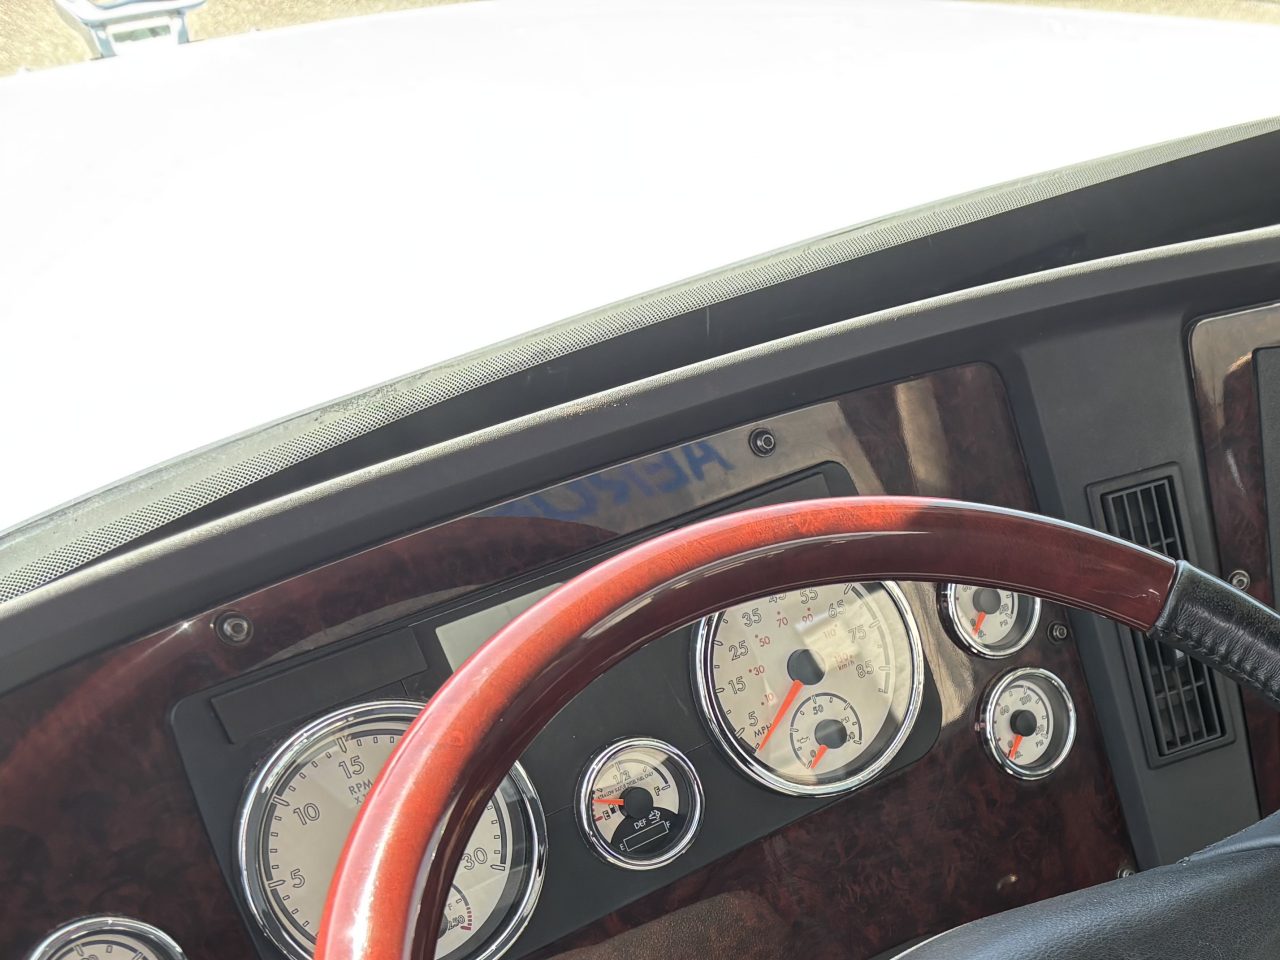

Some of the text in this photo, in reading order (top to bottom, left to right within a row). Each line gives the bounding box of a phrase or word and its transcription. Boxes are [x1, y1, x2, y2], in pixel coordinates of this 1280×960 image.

[800, 587, 819, 604] 55
[828, 599, 846, 618] 65
[742, 608, 762, 627] 35
[776, 616, 789, 628] 70
[802, 613, 814, 623] 90
[759, 636, 771, 647] 50
[848, 624, 867, 643] 75
[728, 640, 749, 662] 25
[753, 665, 765, 676] 30
[856, 660, 874, 678] 85
[728, 676, 747, 695] 15
[812, 704, 824, 715] 50
[748, 711, 759, 727] 5
[338, 755, 365, 780] 15
[613, 770, 631, 785] 1/2
[348, 780, 373, 795] RPM
[654, 786, 660, 796] F
[293, 802, 320, 825] 10
[603, 810, 611, 821] E
[633, 818, 648, 830] DEF
[462, 847, 488, 870] 30
[291, 868, 305, 888] 5
